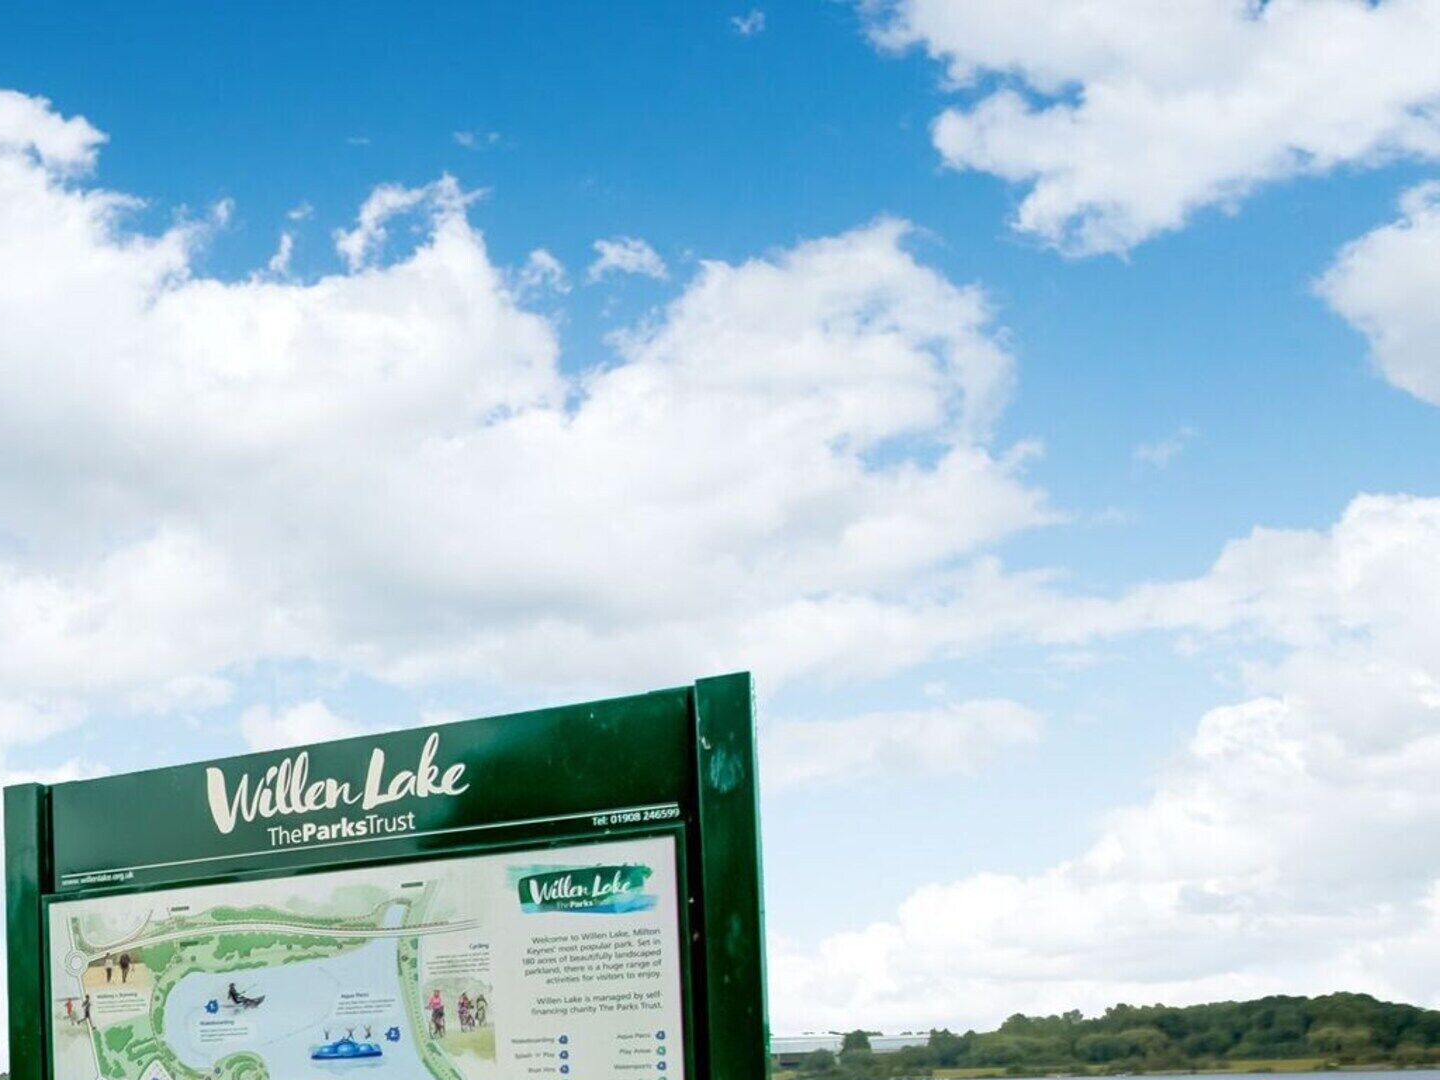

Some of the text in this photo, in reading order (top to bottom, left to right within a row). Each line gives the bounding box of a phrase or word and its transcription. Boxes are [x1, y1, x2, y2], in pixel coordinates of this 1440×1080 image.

[205, 732, 470, 834] Willen Lake
[610, 813, 640, 824] 01908
[643, 808, 680, 820] 246599
[267, 811, 416, 846] TheParksTrust
[529, 870, 630, 905] Willen Lake
[531, 936, 568, 944] Welcome
[580, 932, 607, 941] Willen
[632, 928, 661, 936] Milton
[580, 942, 611, 952] popular
[638, 938, 650, 946] Set
[560, 955, 568, 963] of
[570, 952, 613, 962] beautifully
[614, 949, 662, 959] landscaped
[524, 967, 562, 977] parkland,
[602, 962, 624, 971] huge
[626, 961, 650, 969] range
[546, 975, 580, 985] activities
[596, 972, 624, 982] visitors
[536, 996, 562, 1005] Willen
[592, 992, 632, 1003] managed
[633, 992, 643, 1000] by
[531, 1007, 568, 1016] financing
[570, 1005, 596, 1014] charity
